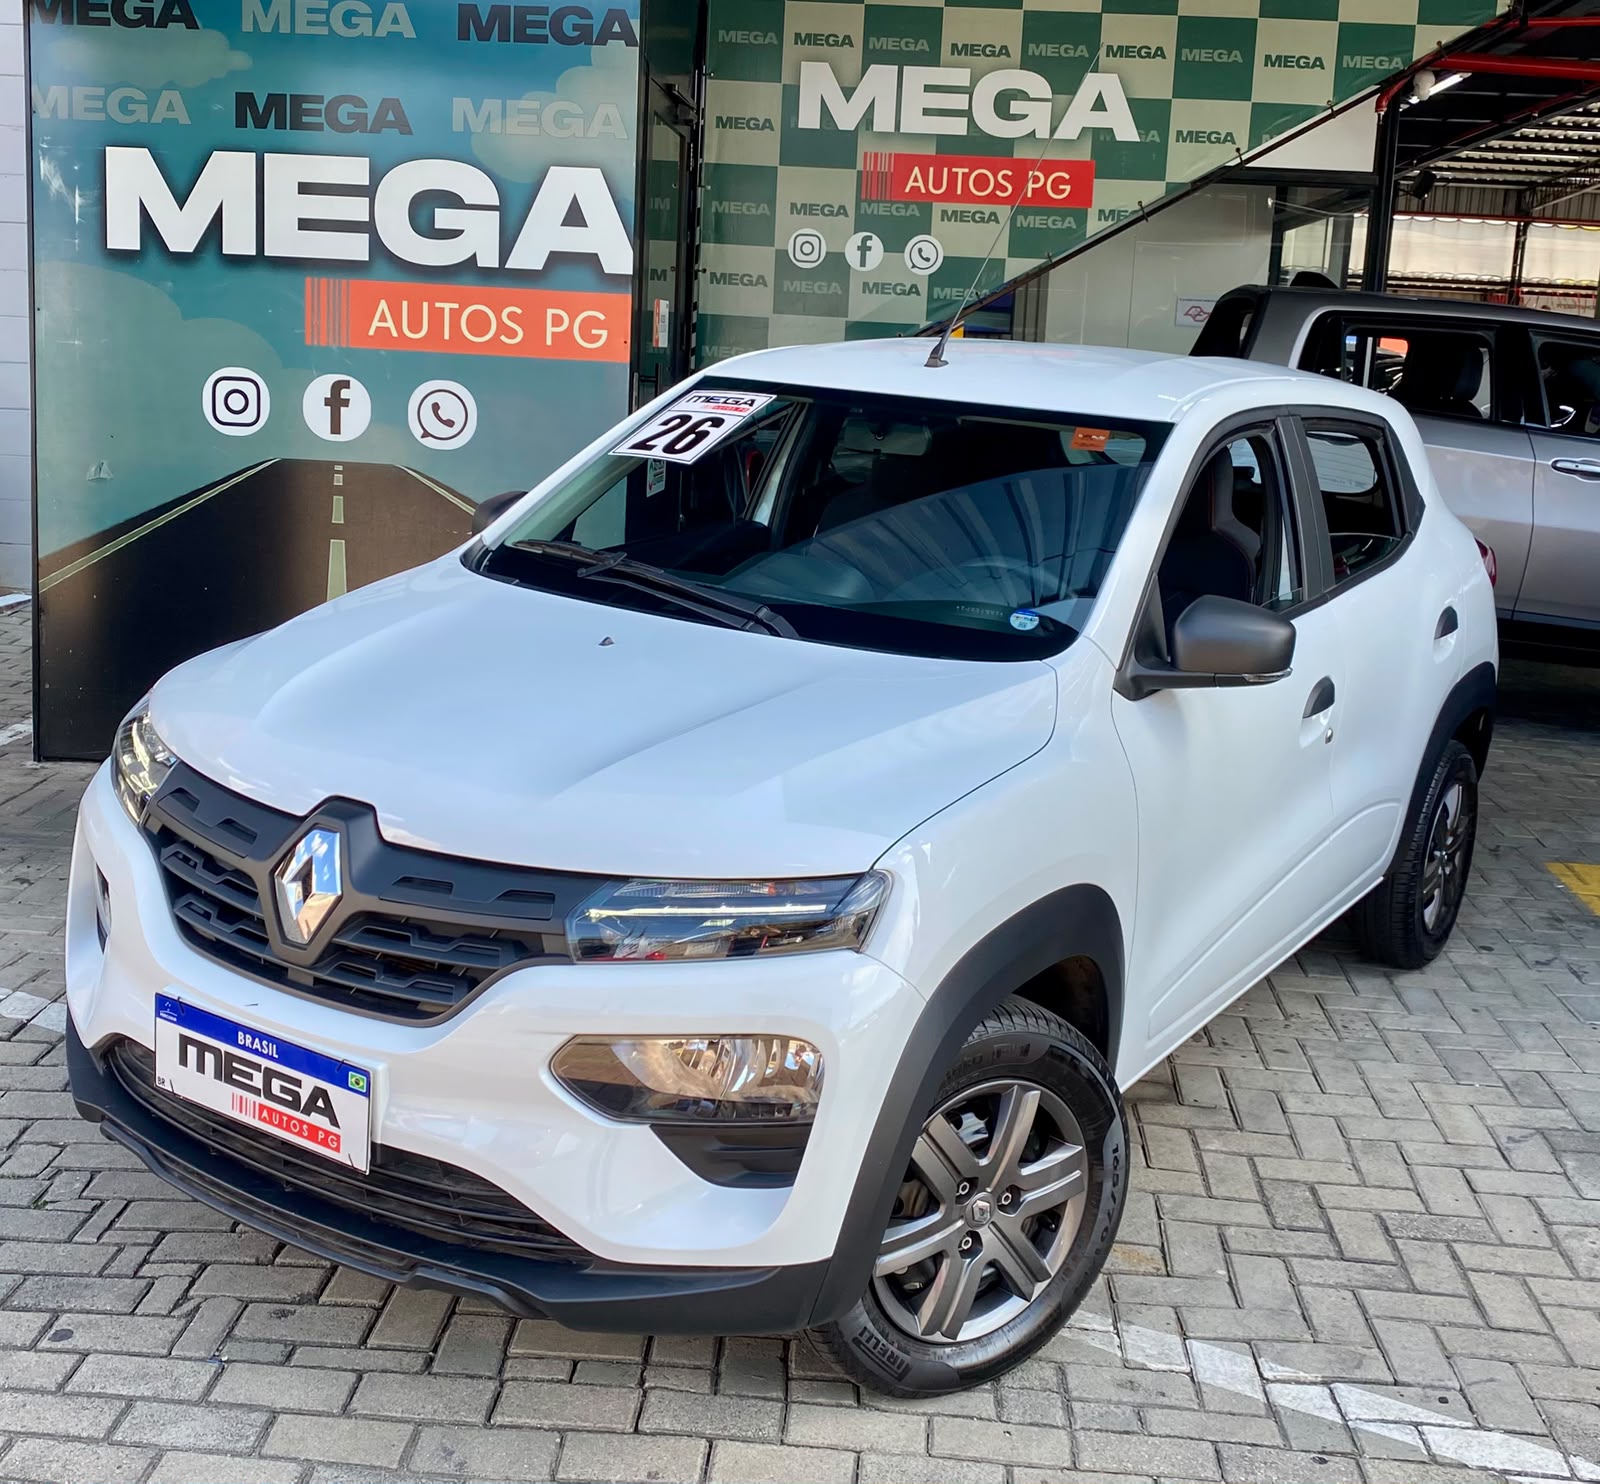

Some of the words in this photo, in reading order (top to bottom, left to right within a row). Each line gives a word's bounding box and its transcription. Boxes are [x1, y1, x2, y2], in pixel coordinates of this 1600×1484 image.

[31, 0, 200, 30] MEGA
[242, 0, 416, 39] MEGA
[457, 4, 639, 47] MEGA
[718, 30, 778, 45] MEGA
[794, 32, 854, 48] MEGA
[869, 37, 929, 53] MEGA
[950, 43, 1011, 58] MEGA
[1028, 42, 1089, 58] MEGA
[1105, 44, 1167, 60] MEGA
[1181, 48, 1243, 63] MEGA
[1263, 54, 1325, 70] MEGA
[1342, 55, 1404, 70] MEGA
[31, 84, 192, 125] MEGA
[235, 92, 413, 136] MEGA
[452, 97, 629, 139] MEGA
[798, 61, 1140, 142] MEGA
[715, 115, 775, 132] MEGA
[1175, 129, 1236, 145] MEGA
[904, 166, 1013, 198] AUTOS
[1026, 170, 1072, 200] PG
[105, 146, 634, 275] MEGA
[711, 200, 771, 216] MEGA
[789, 202, 849, 218] MEGA
[860, 202, 920, 217] MEGA
[940, 209, 1000, 224] MEGA
[1016, 214, 1077, 229] MEGA
[709, 272, 768, 288] MEGA
[783, 280, 842, 295] MEGA
[862, 281, 921, 297] MEGA
[368, 299, 525, 346] AUTOS
[545, 307, 609, 349] PG
[627, 414, 726, 455] 26
[237, 1031, 279, 1059] BRASIL
[178, 1032, 341, 1129] MEGA
[261, 1108, 308, 1137] AUTOS
[317, 1131, 338, 1149] PG
[852, 1326, 912, 1382] PIRELLI
